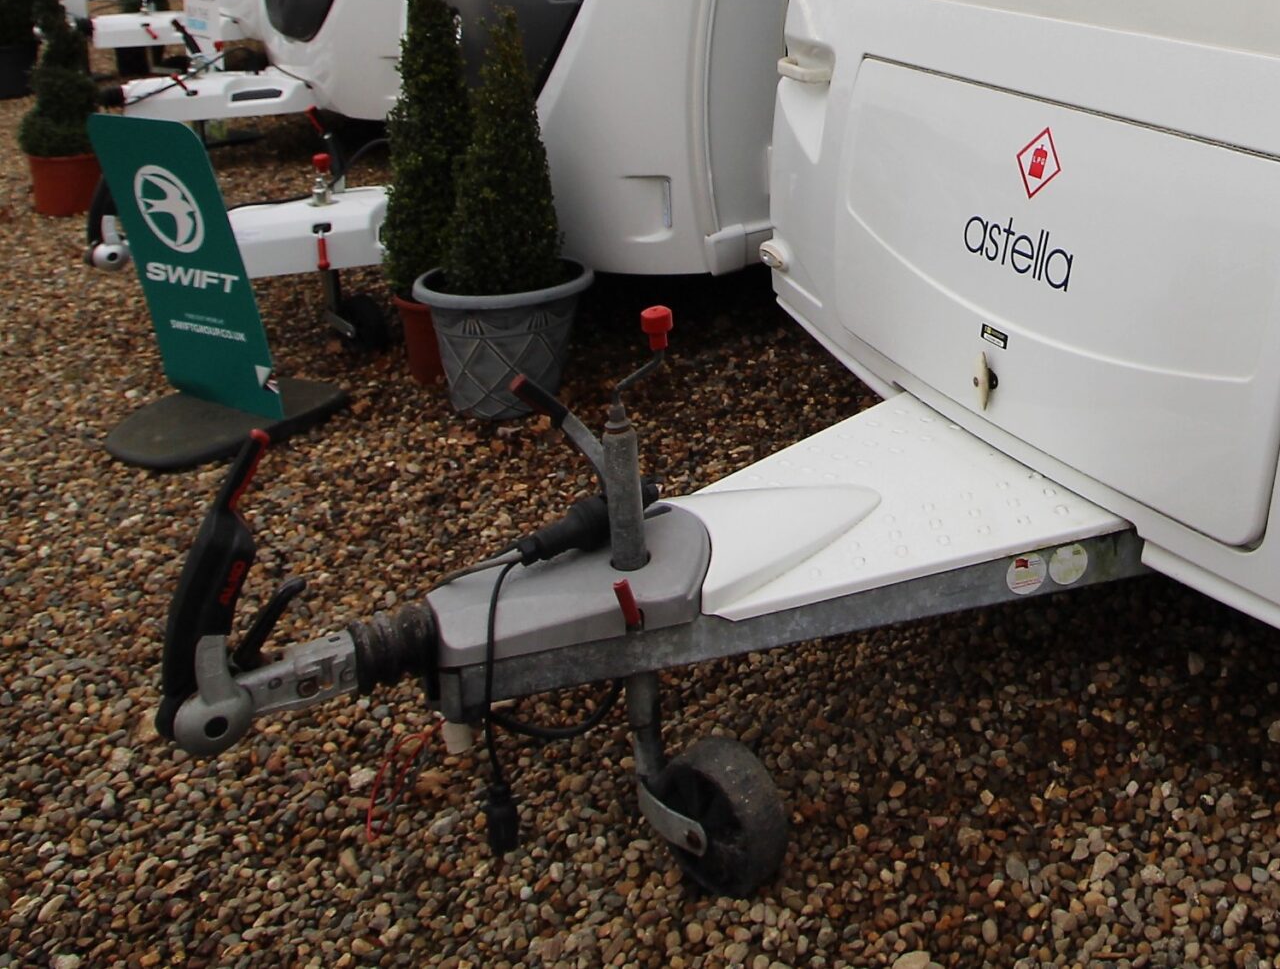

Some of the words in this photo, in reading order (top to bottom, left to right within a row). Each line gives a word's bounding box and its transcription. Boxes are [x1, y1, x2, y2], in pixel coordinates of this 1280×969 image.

[1032, 155, 1046, 166] LPG
[964, 216, 1074, 292] astella
[146, 262, 240, 293] SWIFT
